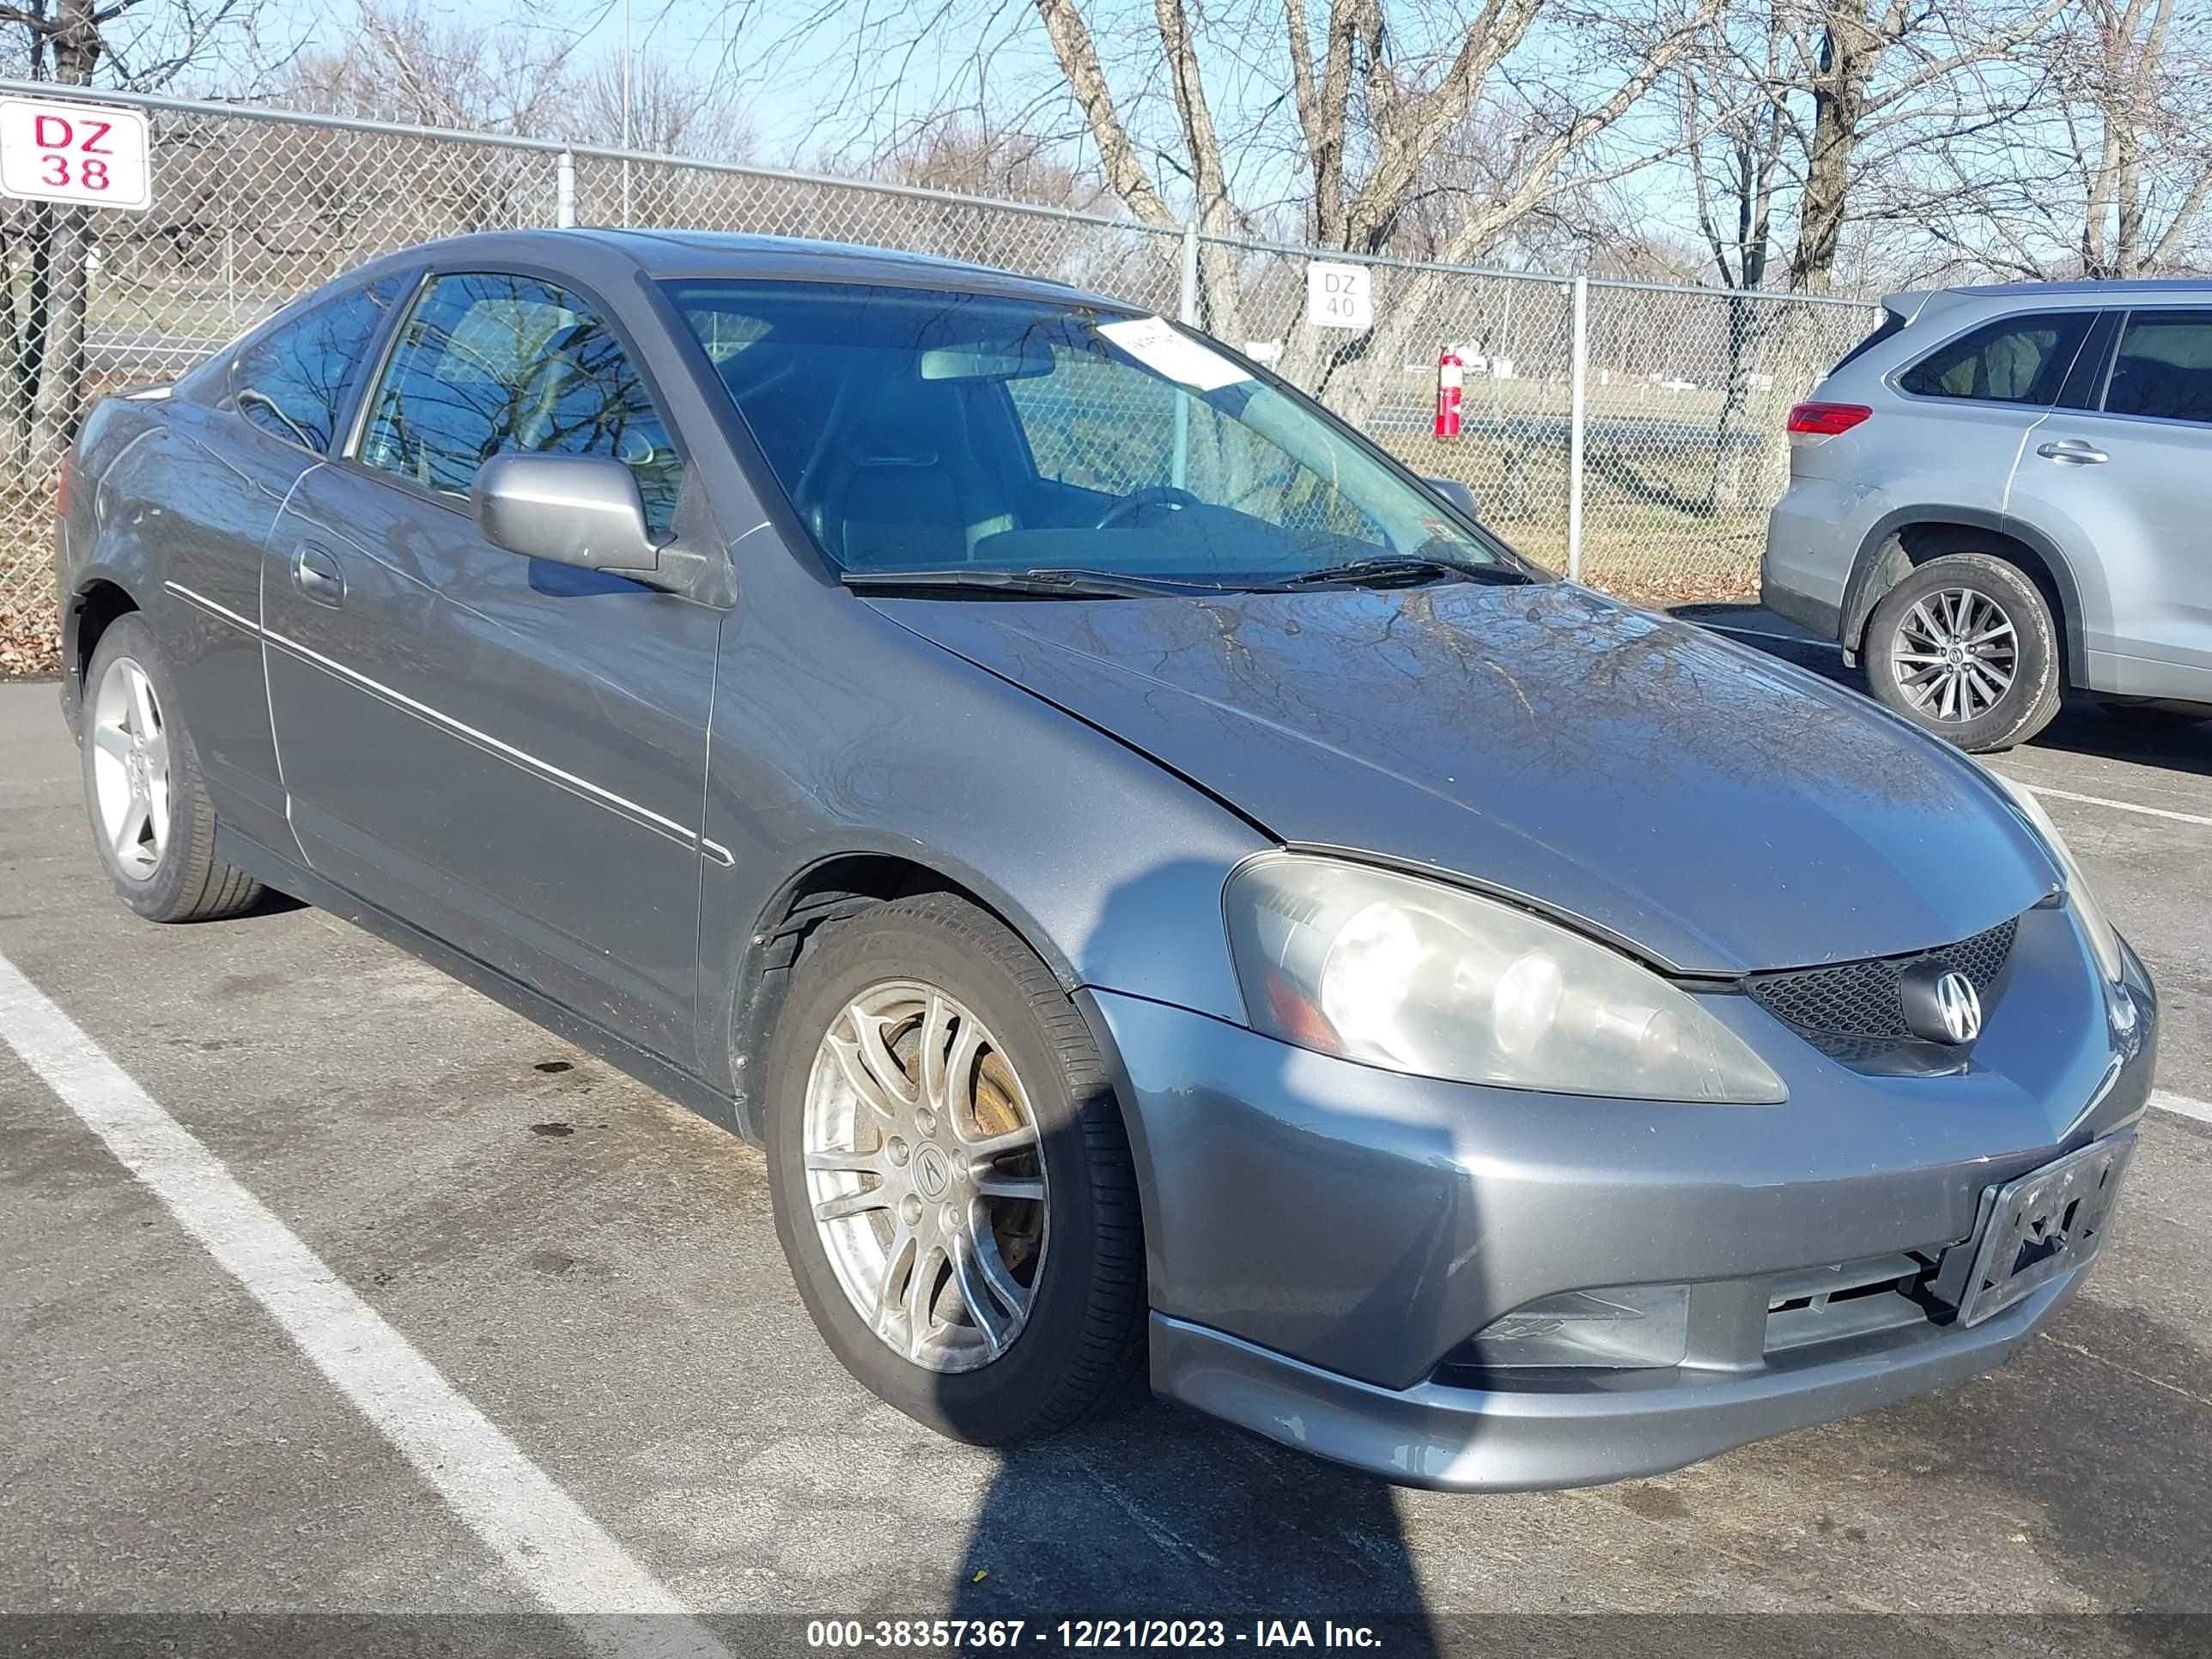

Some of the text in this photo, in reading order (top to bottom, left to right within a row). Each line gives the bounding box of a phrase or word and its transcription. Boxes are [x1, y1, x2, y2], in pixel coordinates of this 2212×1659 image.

[35, 115, 112, 155] DZ
[42, 155, 110, 191] 38
[1325, 273, 1356, 295] DZ
[1327, 297, 1354, 317] 40
